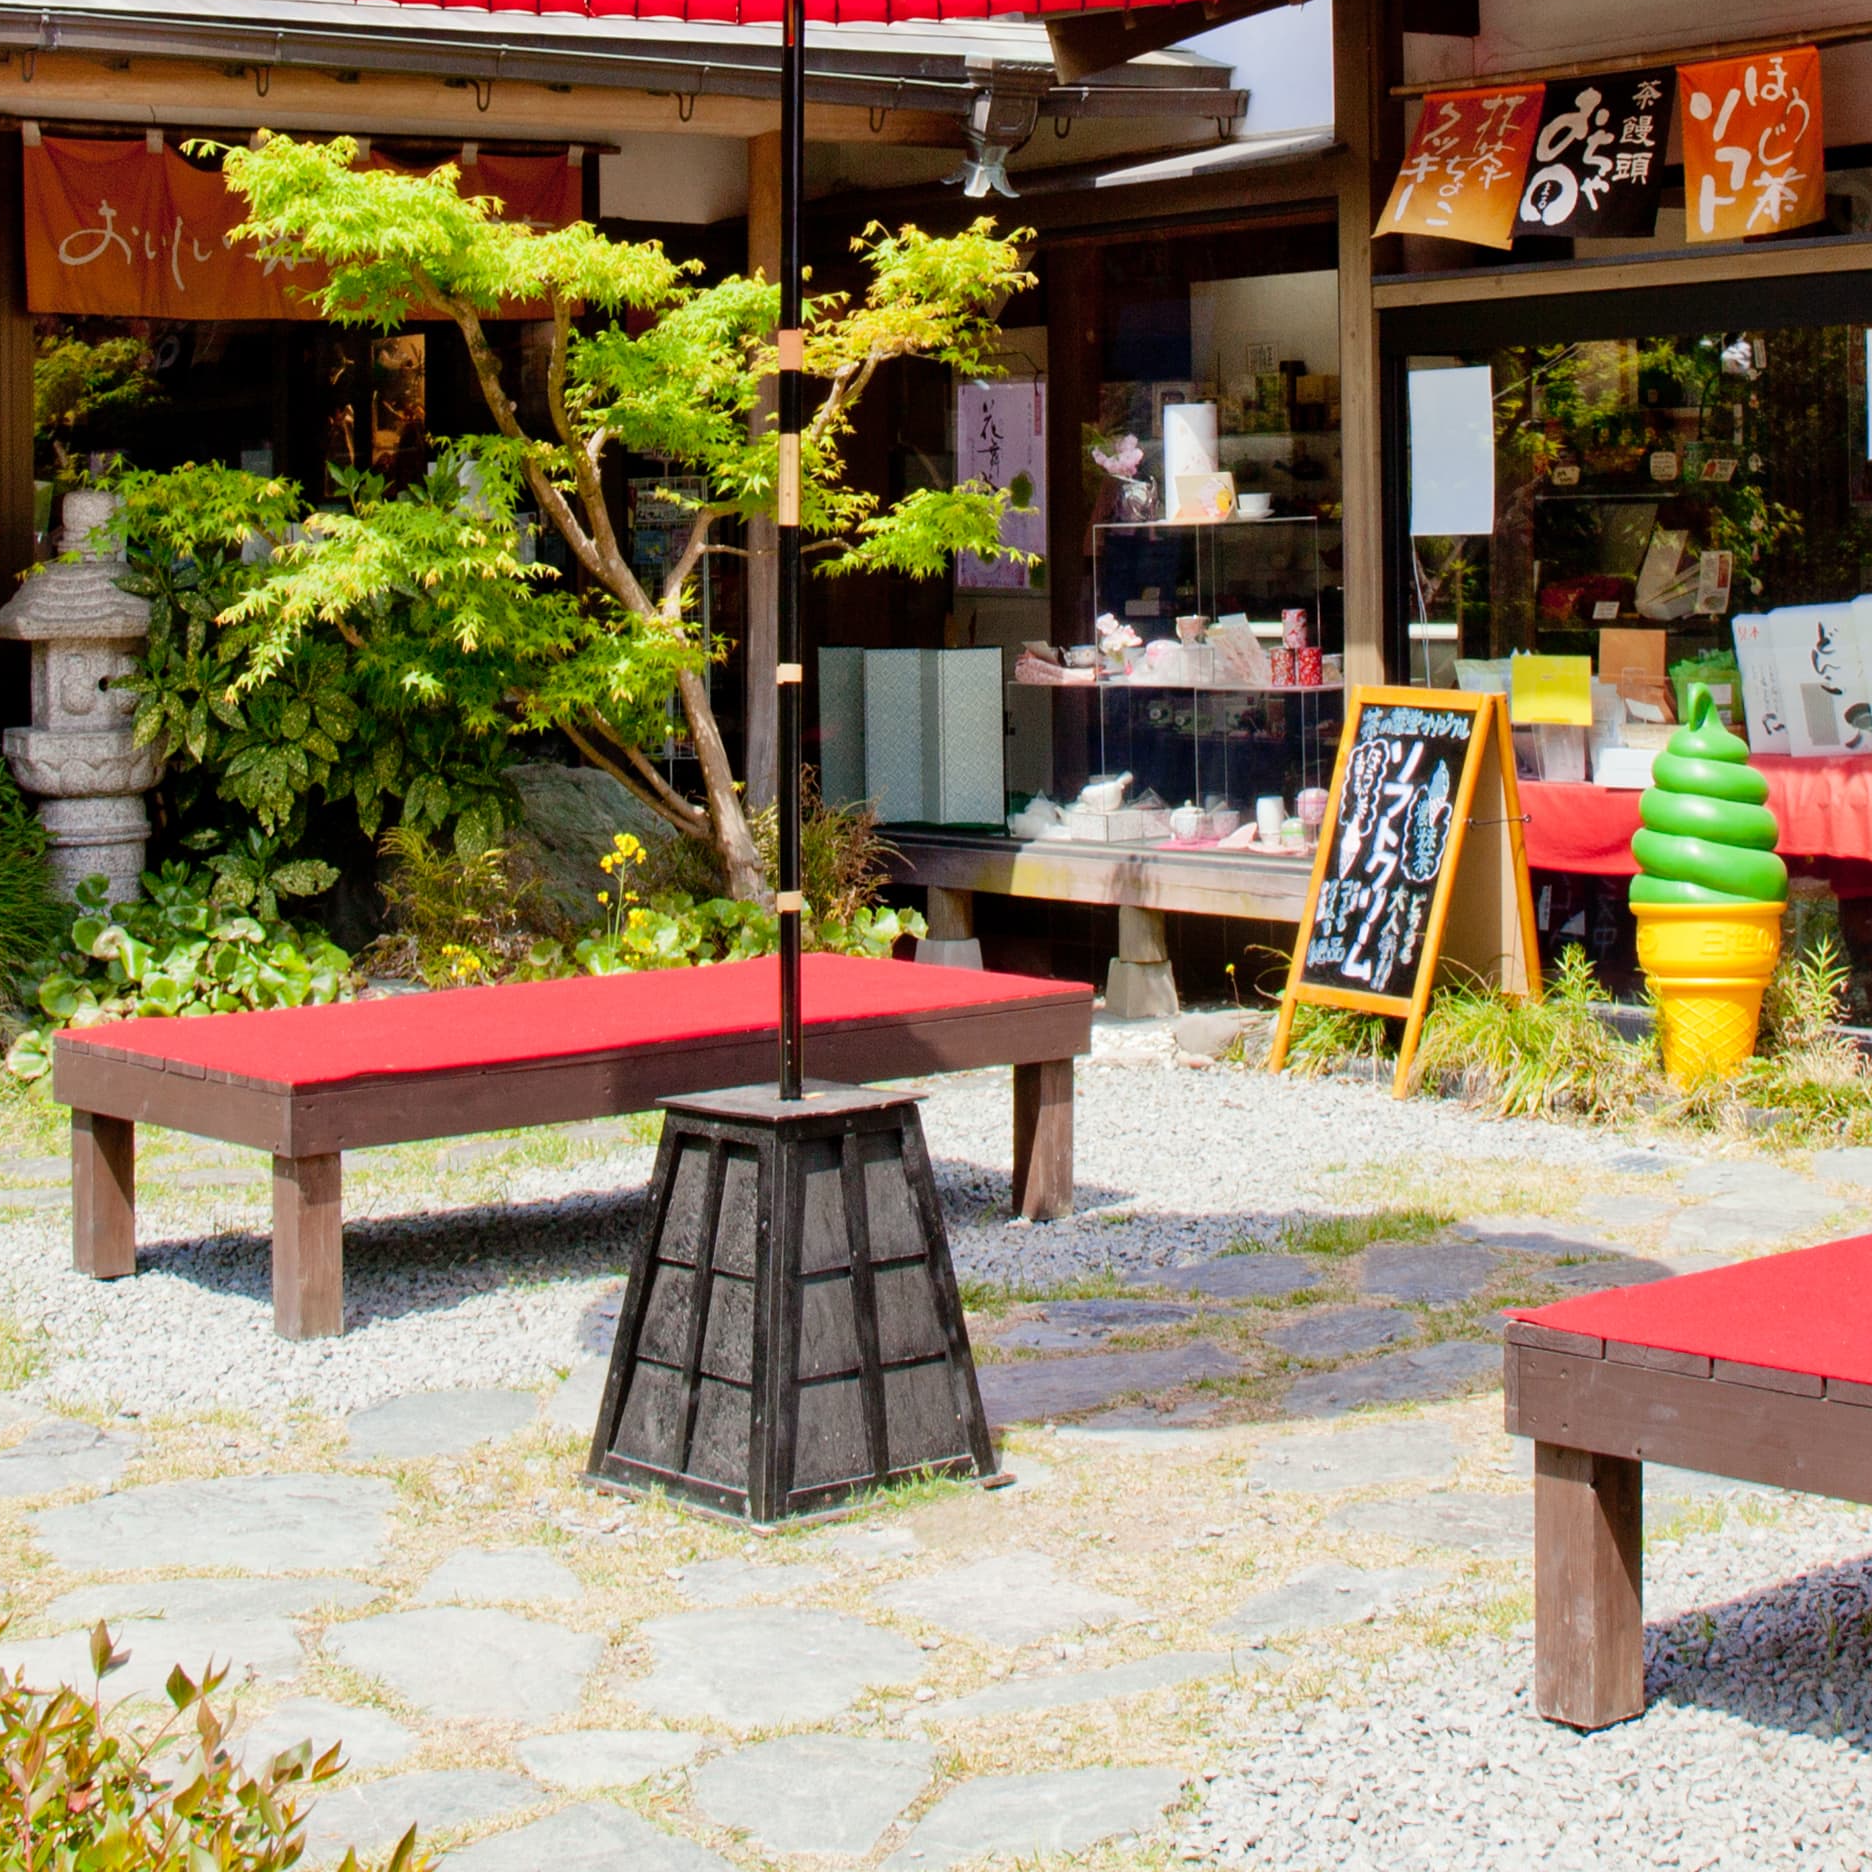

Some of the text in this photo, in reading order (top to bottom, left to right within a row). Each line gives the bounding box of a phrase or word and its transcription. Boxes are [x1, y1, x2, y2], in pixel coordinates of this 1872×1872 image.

[1615, 79, 1663, 185] 茶饅頭
[1689, 89, 1752, 233] ソフト
[1745, 56, 1811, 230] ほうじ茶
[1341, 740, 1424, 980] ソフトクリーム
